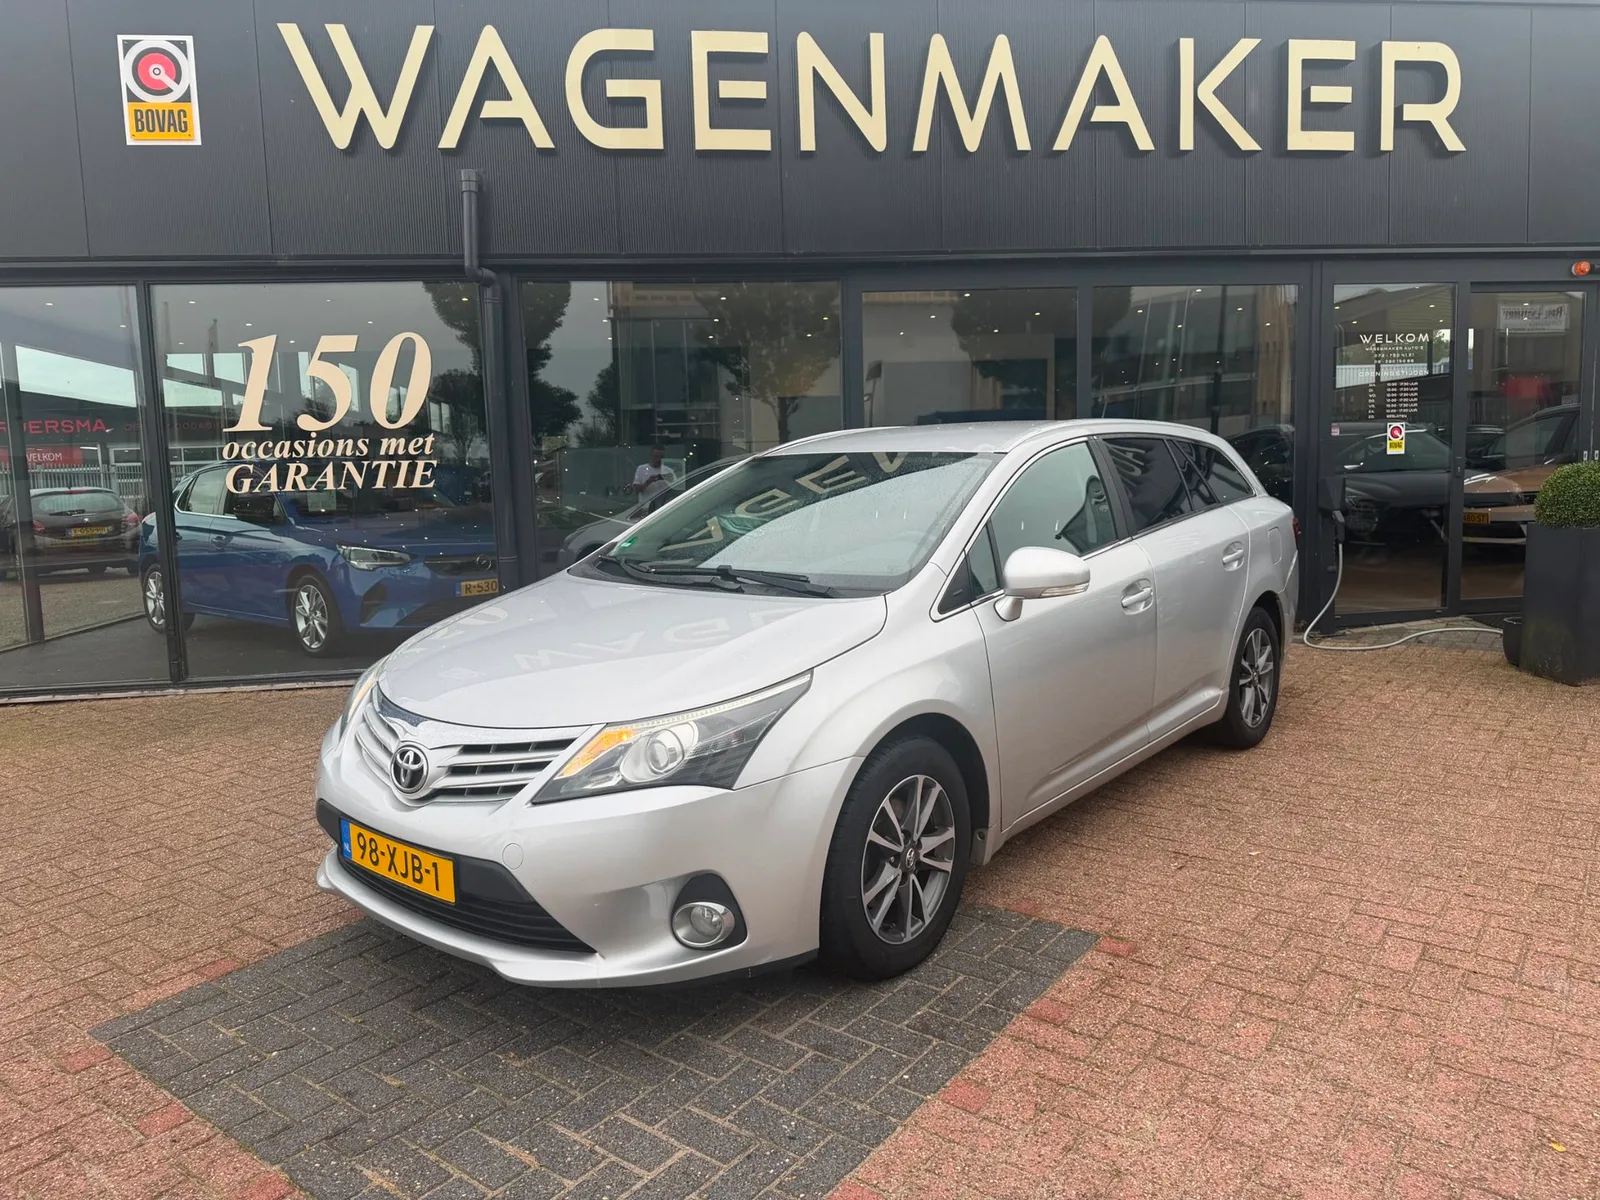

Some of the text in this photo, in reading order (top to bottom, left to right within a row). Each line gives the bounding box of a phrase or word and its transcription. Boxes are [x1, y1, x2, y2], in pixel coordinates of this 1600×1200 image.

[277, 22, 1467, 152] WAGENMAKER
[133, 109, 189, 135] BOVAG
[1360, 333, 1429, 343] WELKOM
[222, 331, 432, 432] 150
[222, 432, 435, 460] occasions met
[225, 459, 438, 494] GARANTIE
[357, 832, 439, 891] 98-XJB-1
